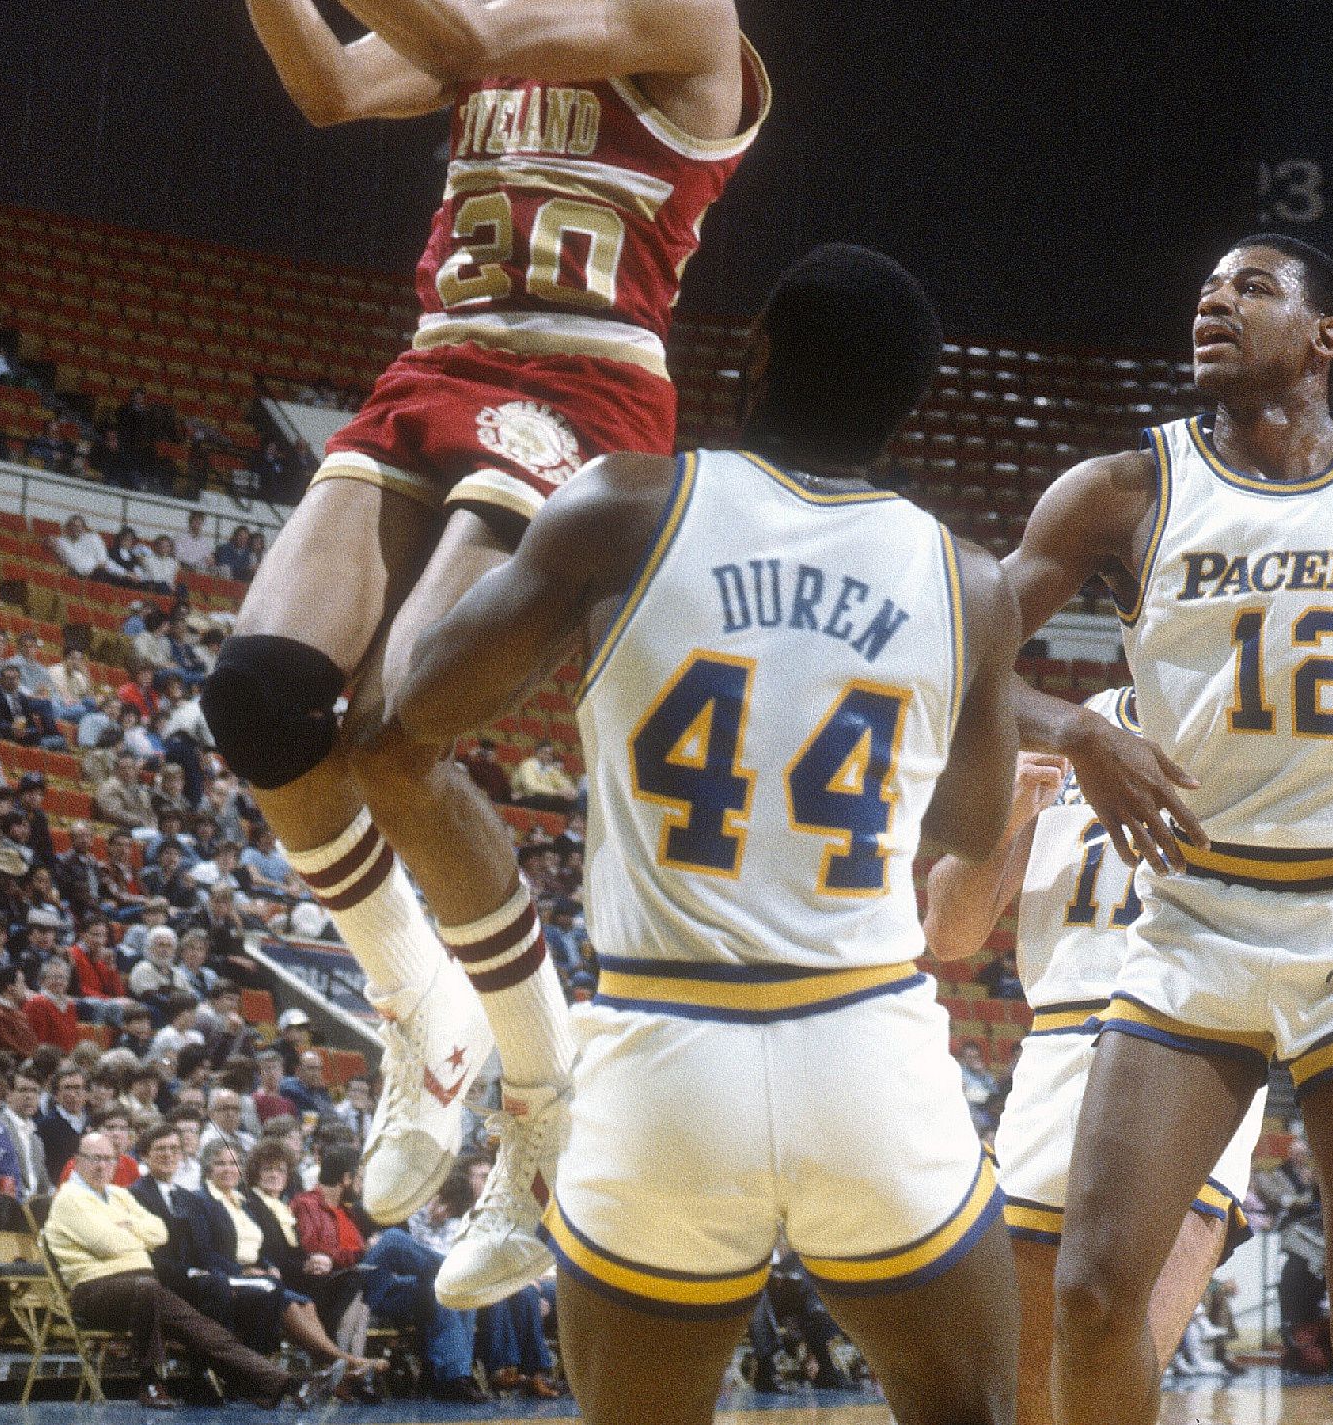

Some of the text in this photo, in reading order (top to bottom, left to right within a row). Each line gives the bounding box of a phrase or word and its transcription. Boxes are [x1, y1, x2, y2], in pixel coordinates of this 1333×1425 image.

[435, 191, 625, 308] 20
[712, 559, 910, 664] DUREN
[626, 647, 914, 900] 44
